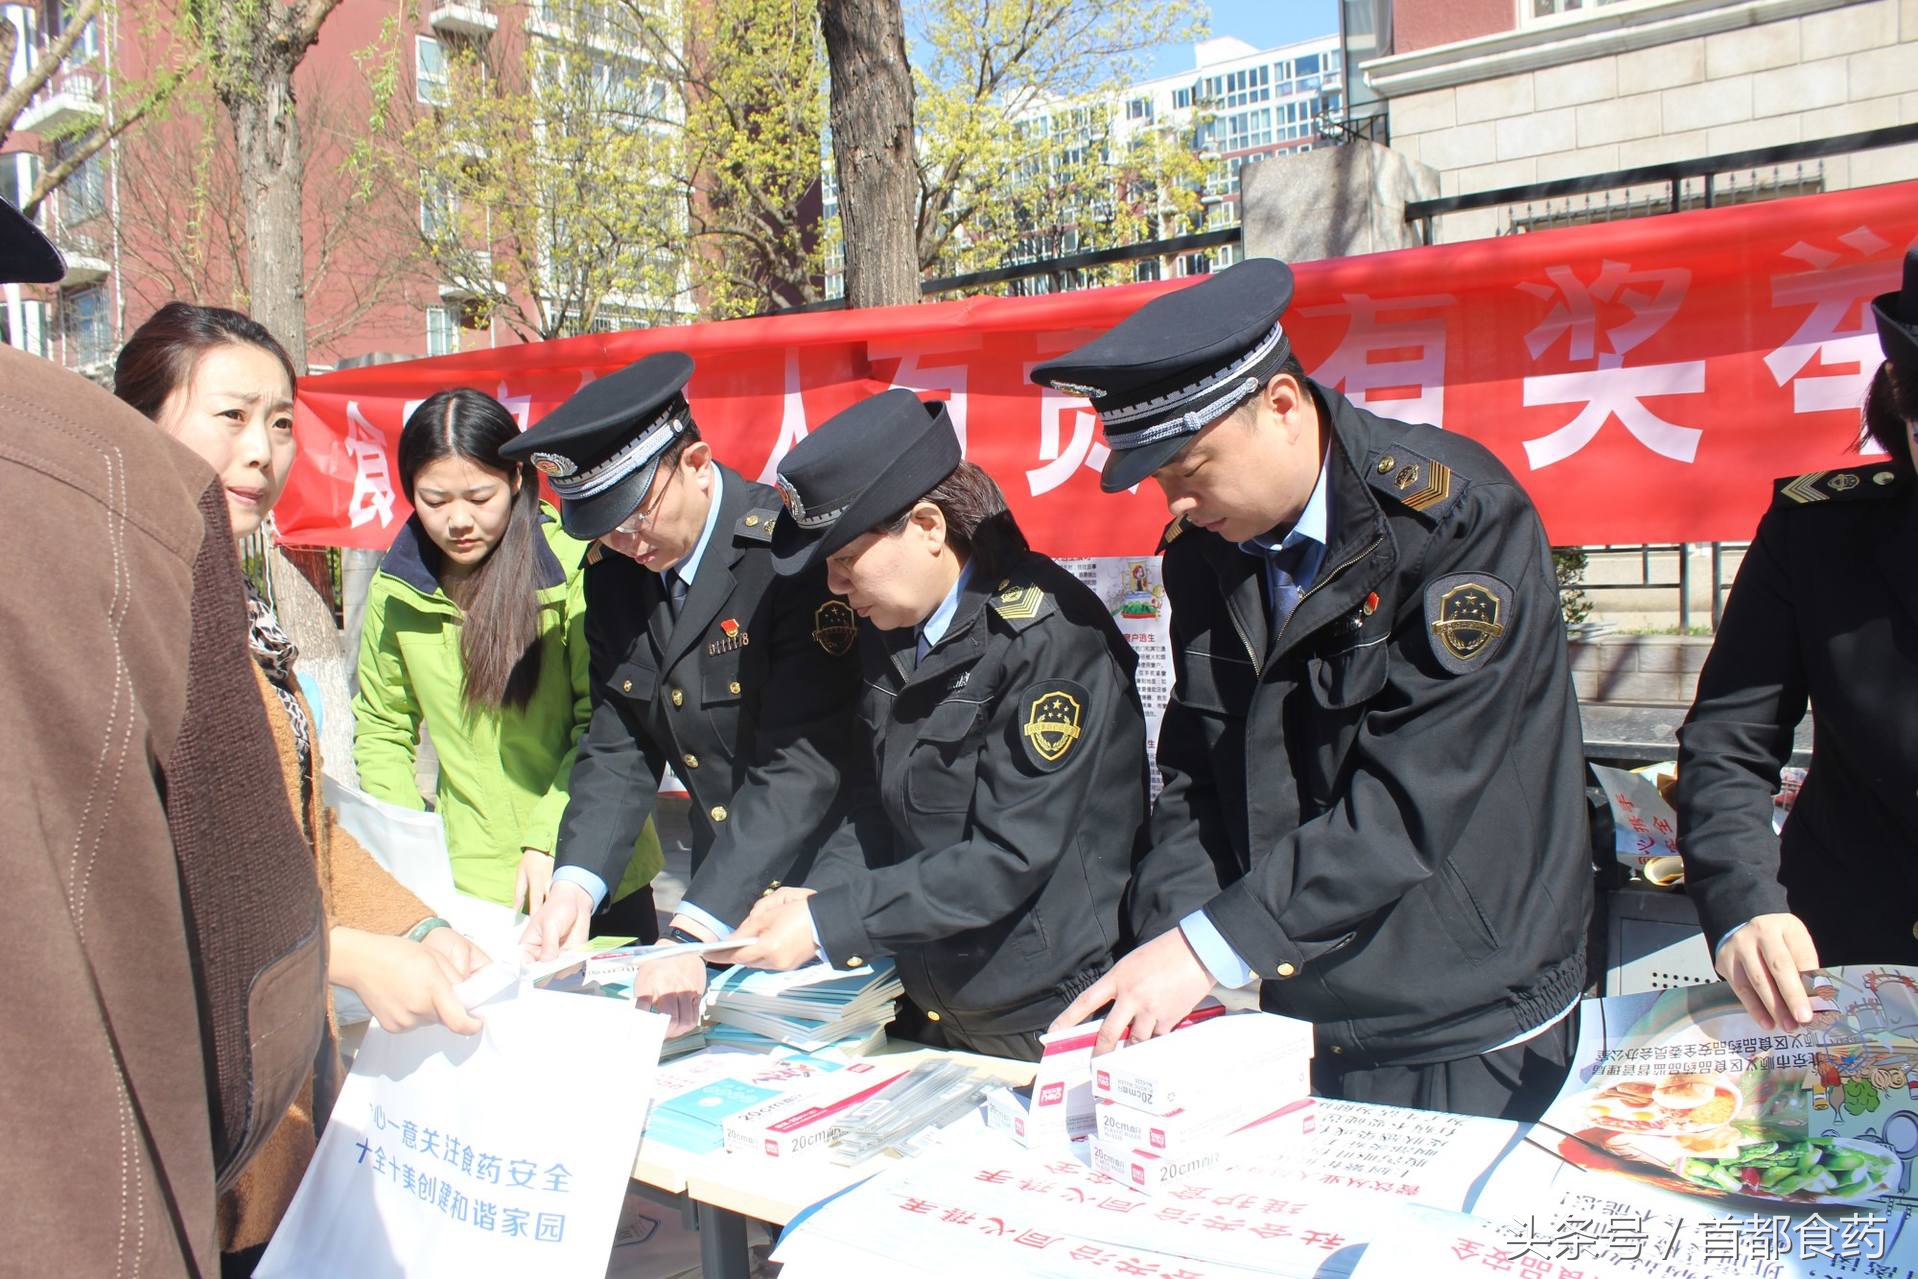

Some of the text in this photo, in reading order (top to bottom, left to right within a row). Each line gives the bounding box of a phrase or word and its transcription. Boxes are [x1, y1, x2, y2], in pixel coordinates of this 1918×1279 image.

[369, 1102, 575, 1194] 心一意关注食药安全
[1153, 1206, 1346, 1251] 社会共治
